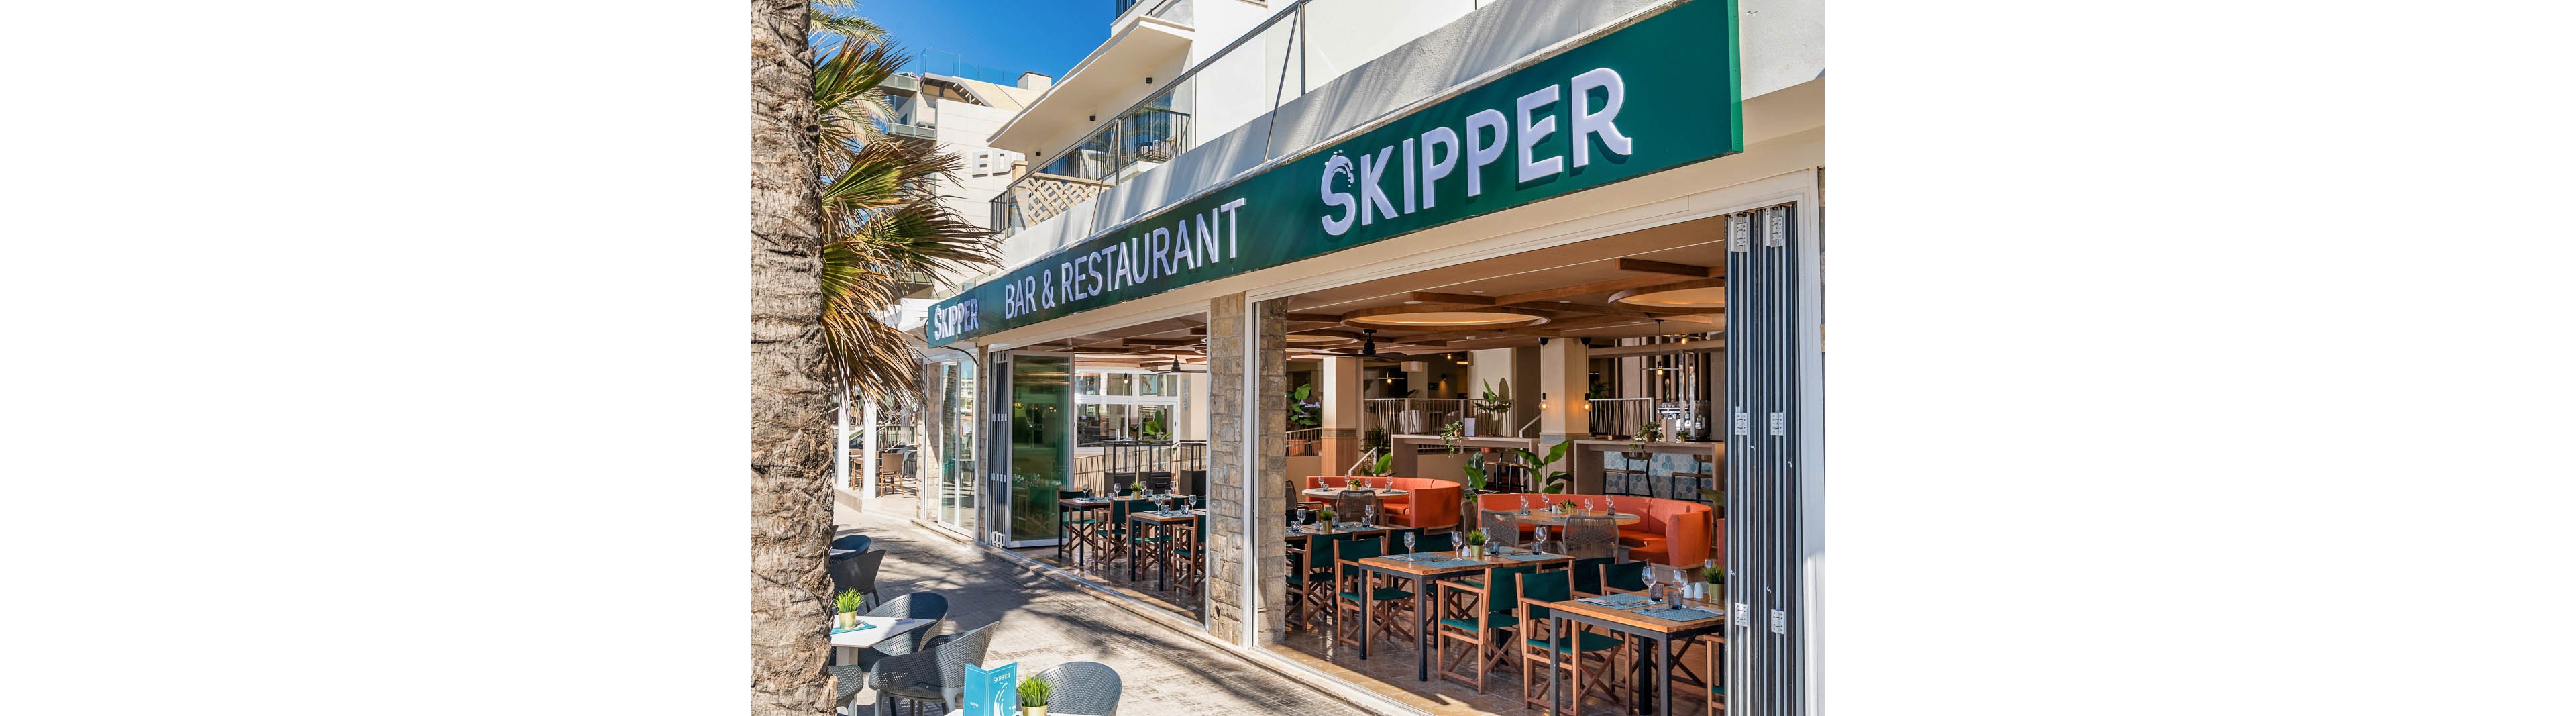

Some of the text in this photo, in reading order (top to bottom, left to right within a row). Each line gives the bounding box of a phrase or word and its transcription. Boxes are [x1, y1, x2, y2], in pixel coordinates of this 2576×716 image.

[1321, 68, 1632, 236] SKIPPER
[1006, 197, 1246, 319] BAR & RESTAURANT
[934, 299, 979, 341] SKIPPER
[993, 672, 1010, 683] SKIPPER
